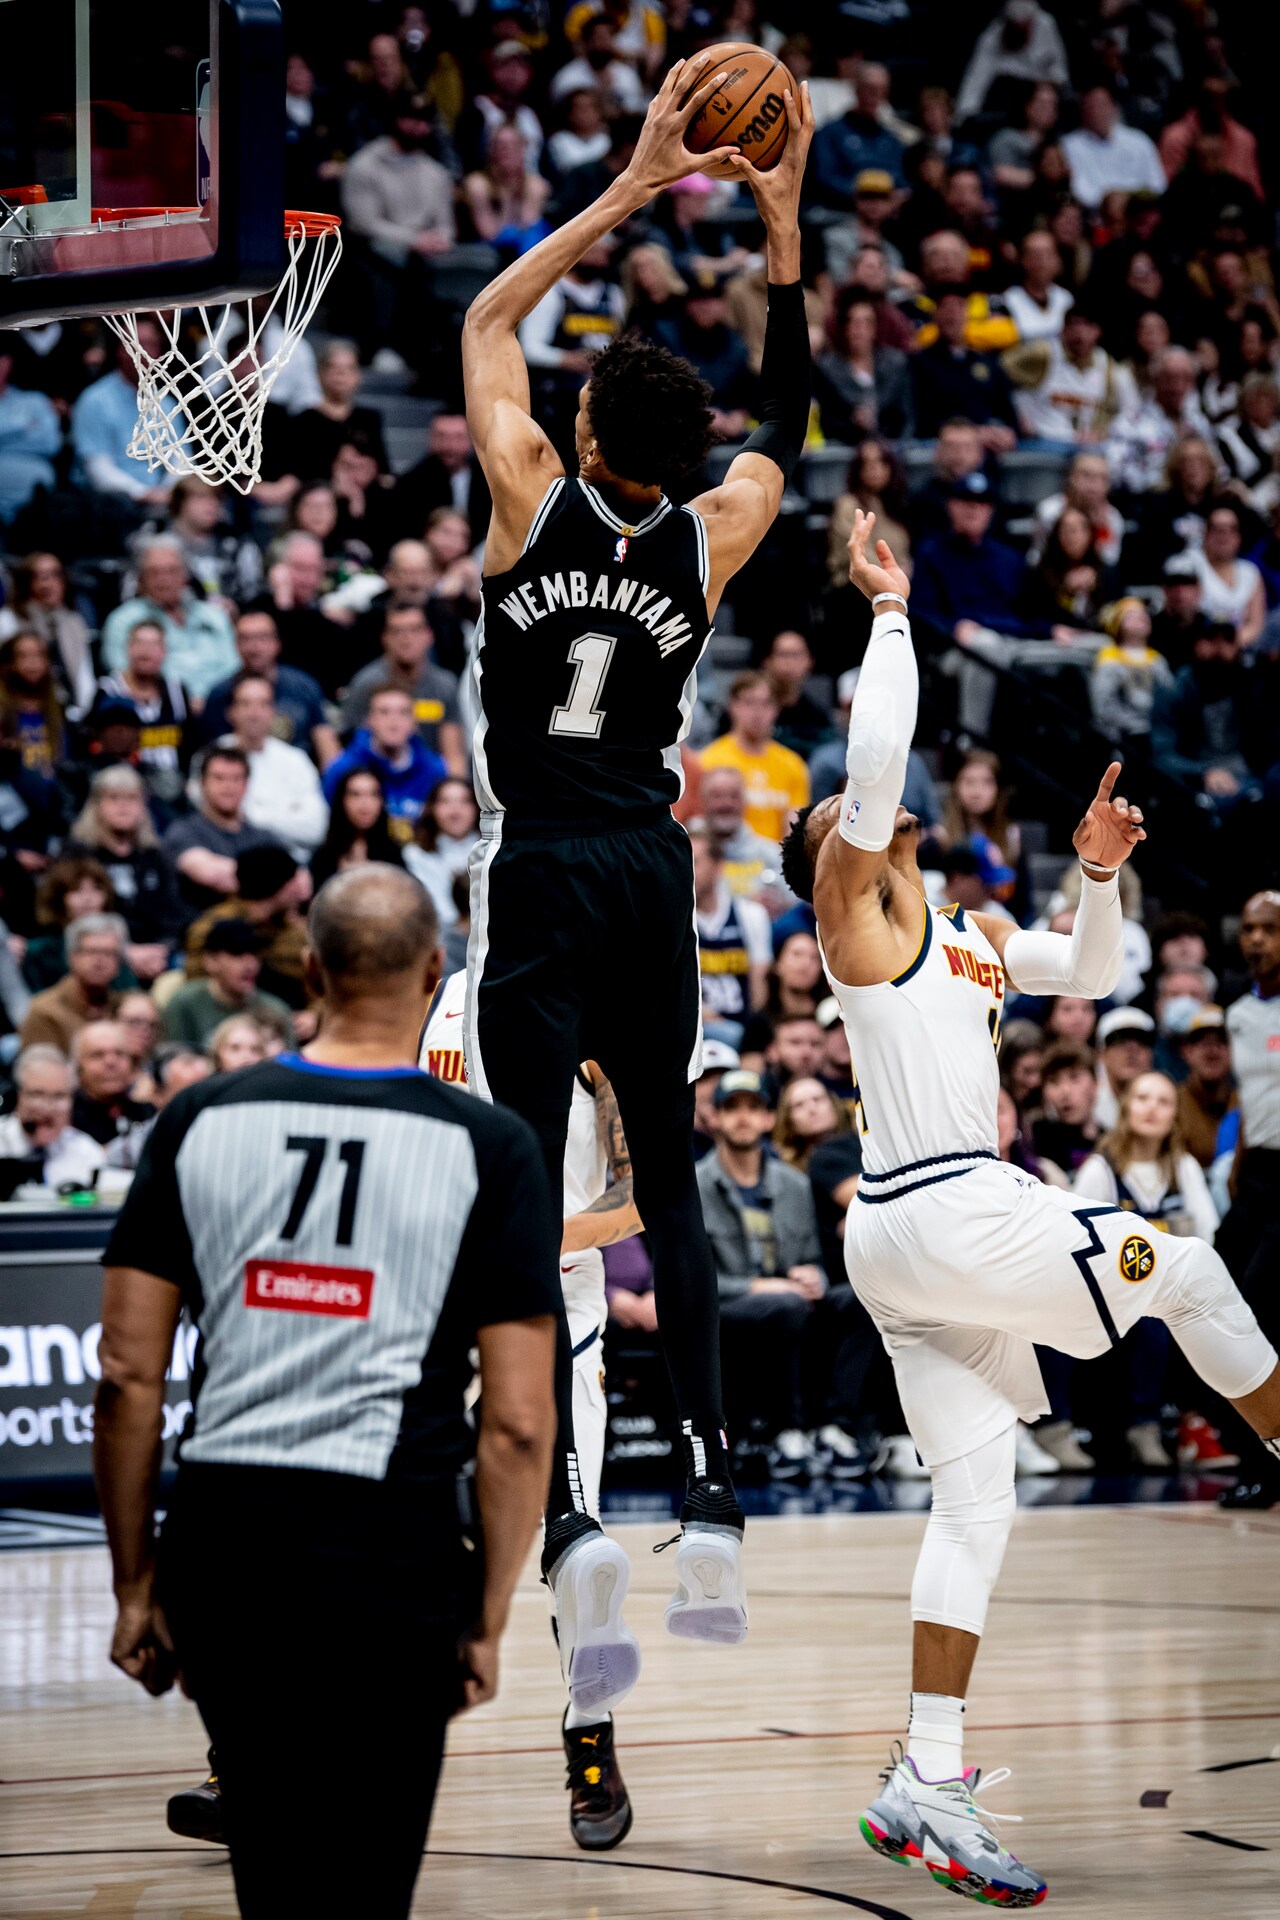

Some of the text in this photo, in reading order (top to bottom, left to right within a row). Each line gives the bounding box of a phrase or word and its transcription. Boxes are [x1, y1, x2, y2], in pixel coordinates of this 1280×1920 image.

[726, 93, 785, 156] Wils
[498, 571, 693, 659] WEMBANYAMA
[548, 632, 617, 739] 1
[279, 1135, 367, 1247] 71
[256, 1269, 362, 1307] Emirates
